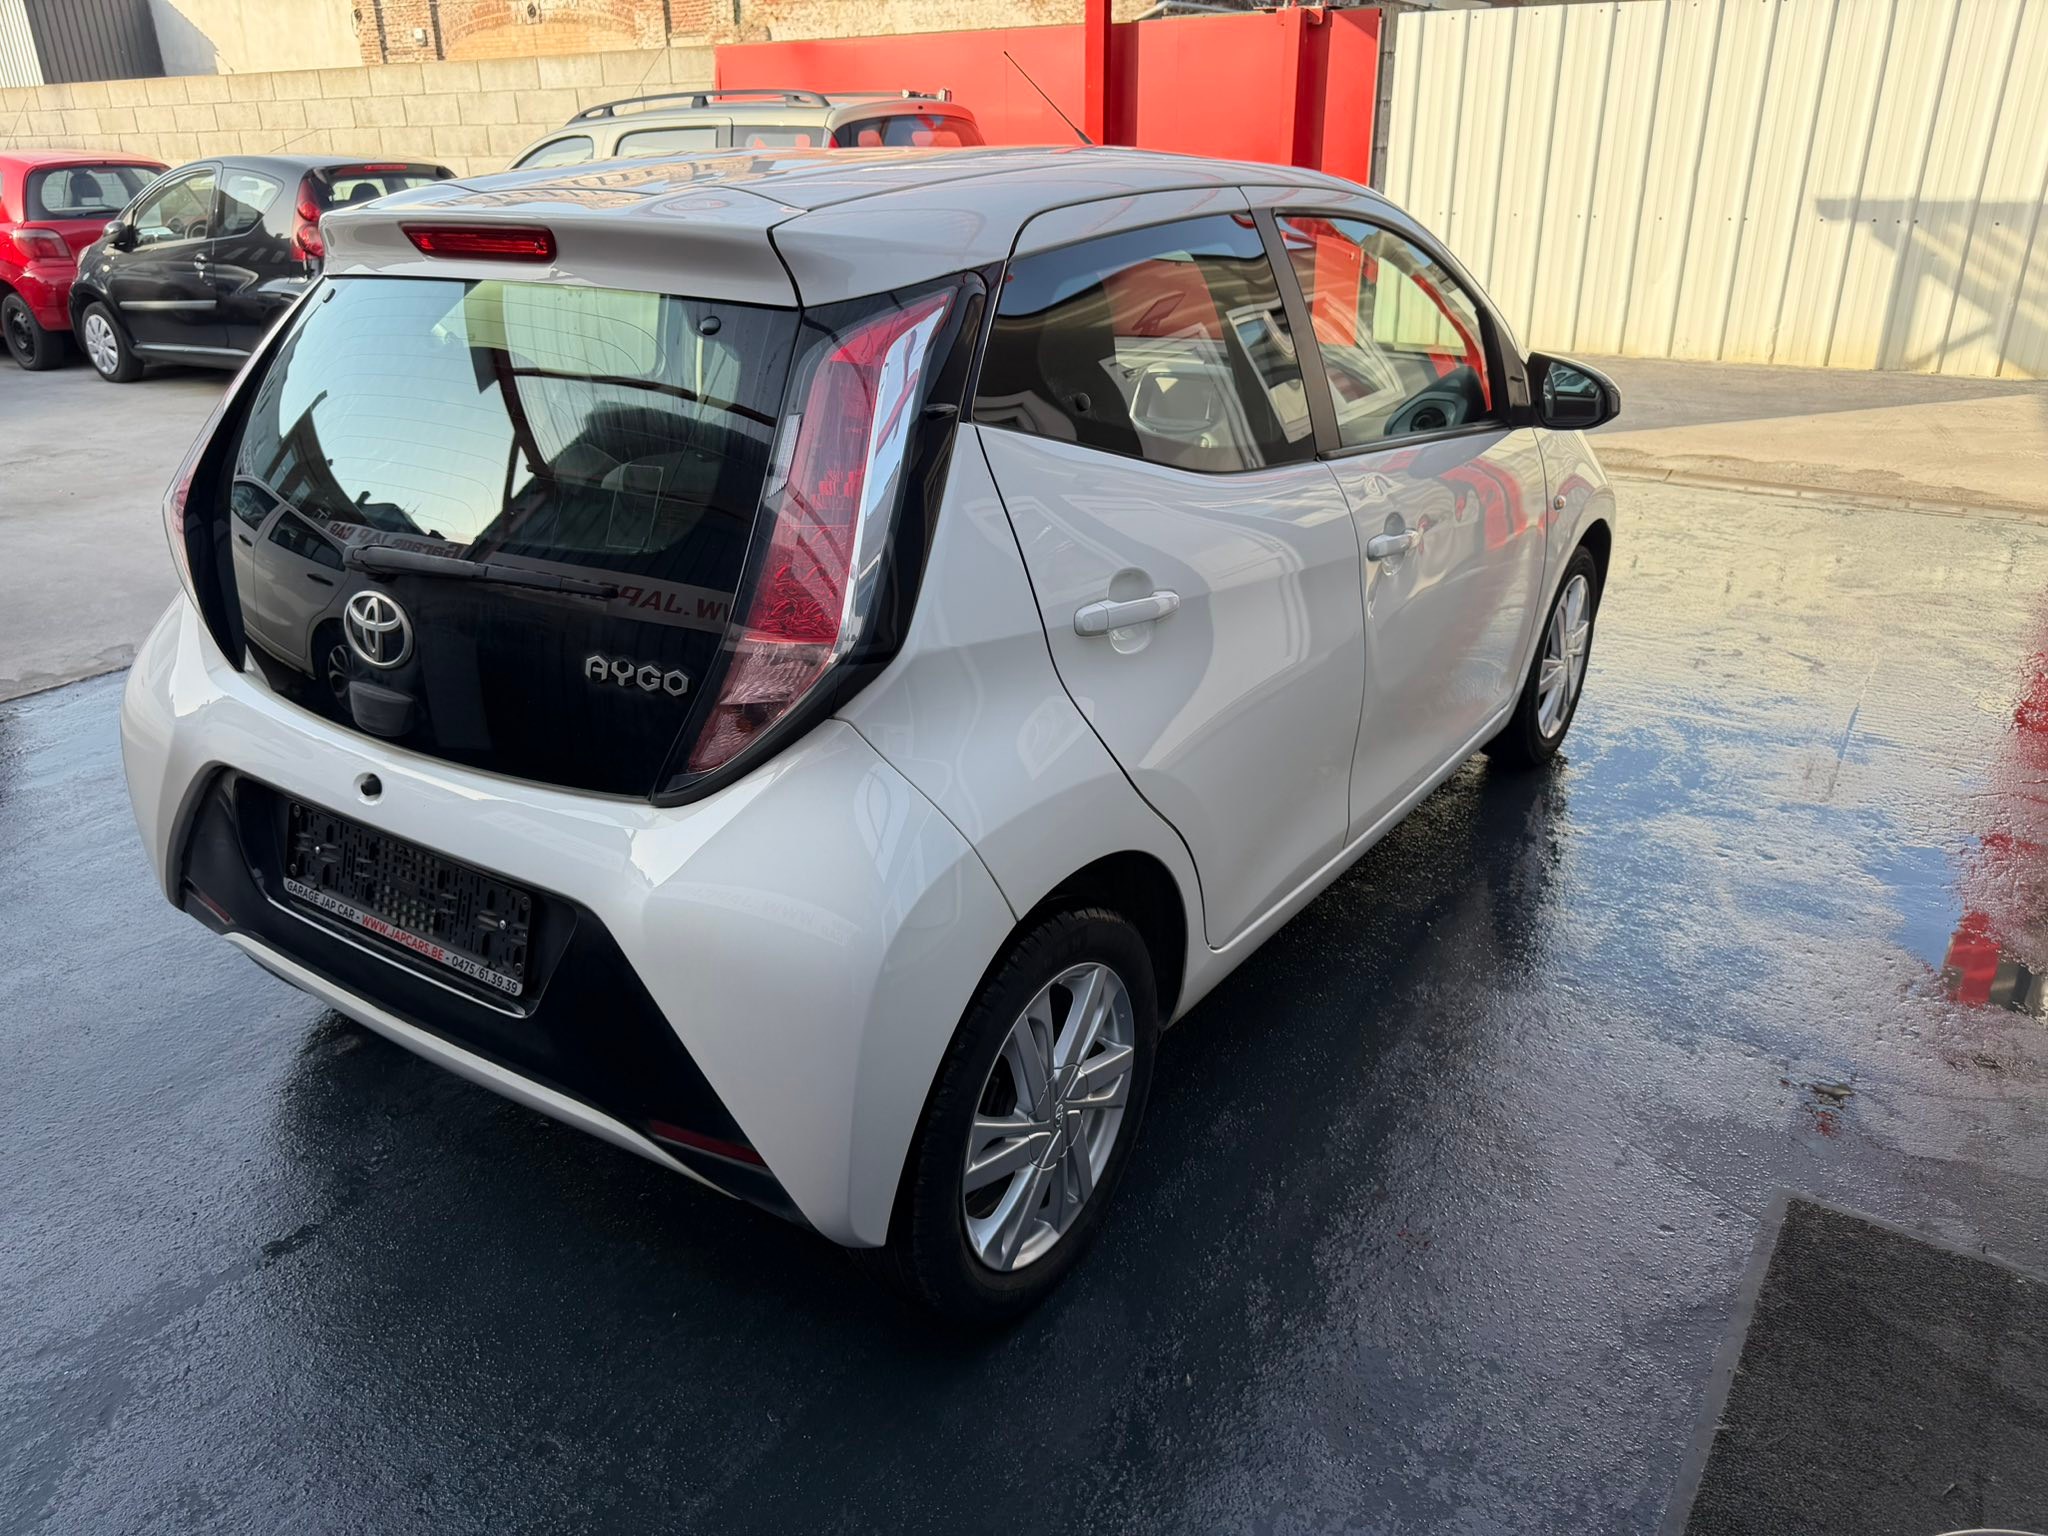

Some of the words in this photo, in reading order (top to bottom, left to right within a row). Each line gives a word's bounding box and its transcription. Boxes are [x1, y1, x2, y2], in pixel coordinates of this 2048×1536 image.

[585, 655, 690, 697] AYGO
[287, 881, 320, 904] GARAGE
[320, 897, 338, 911] JAP
[337, 904, 356, 920] CAR
[362, 914, 445, 961] WWW.JAPCARS.BE
[451, 956, 518, 994] 0475/61.39.39
